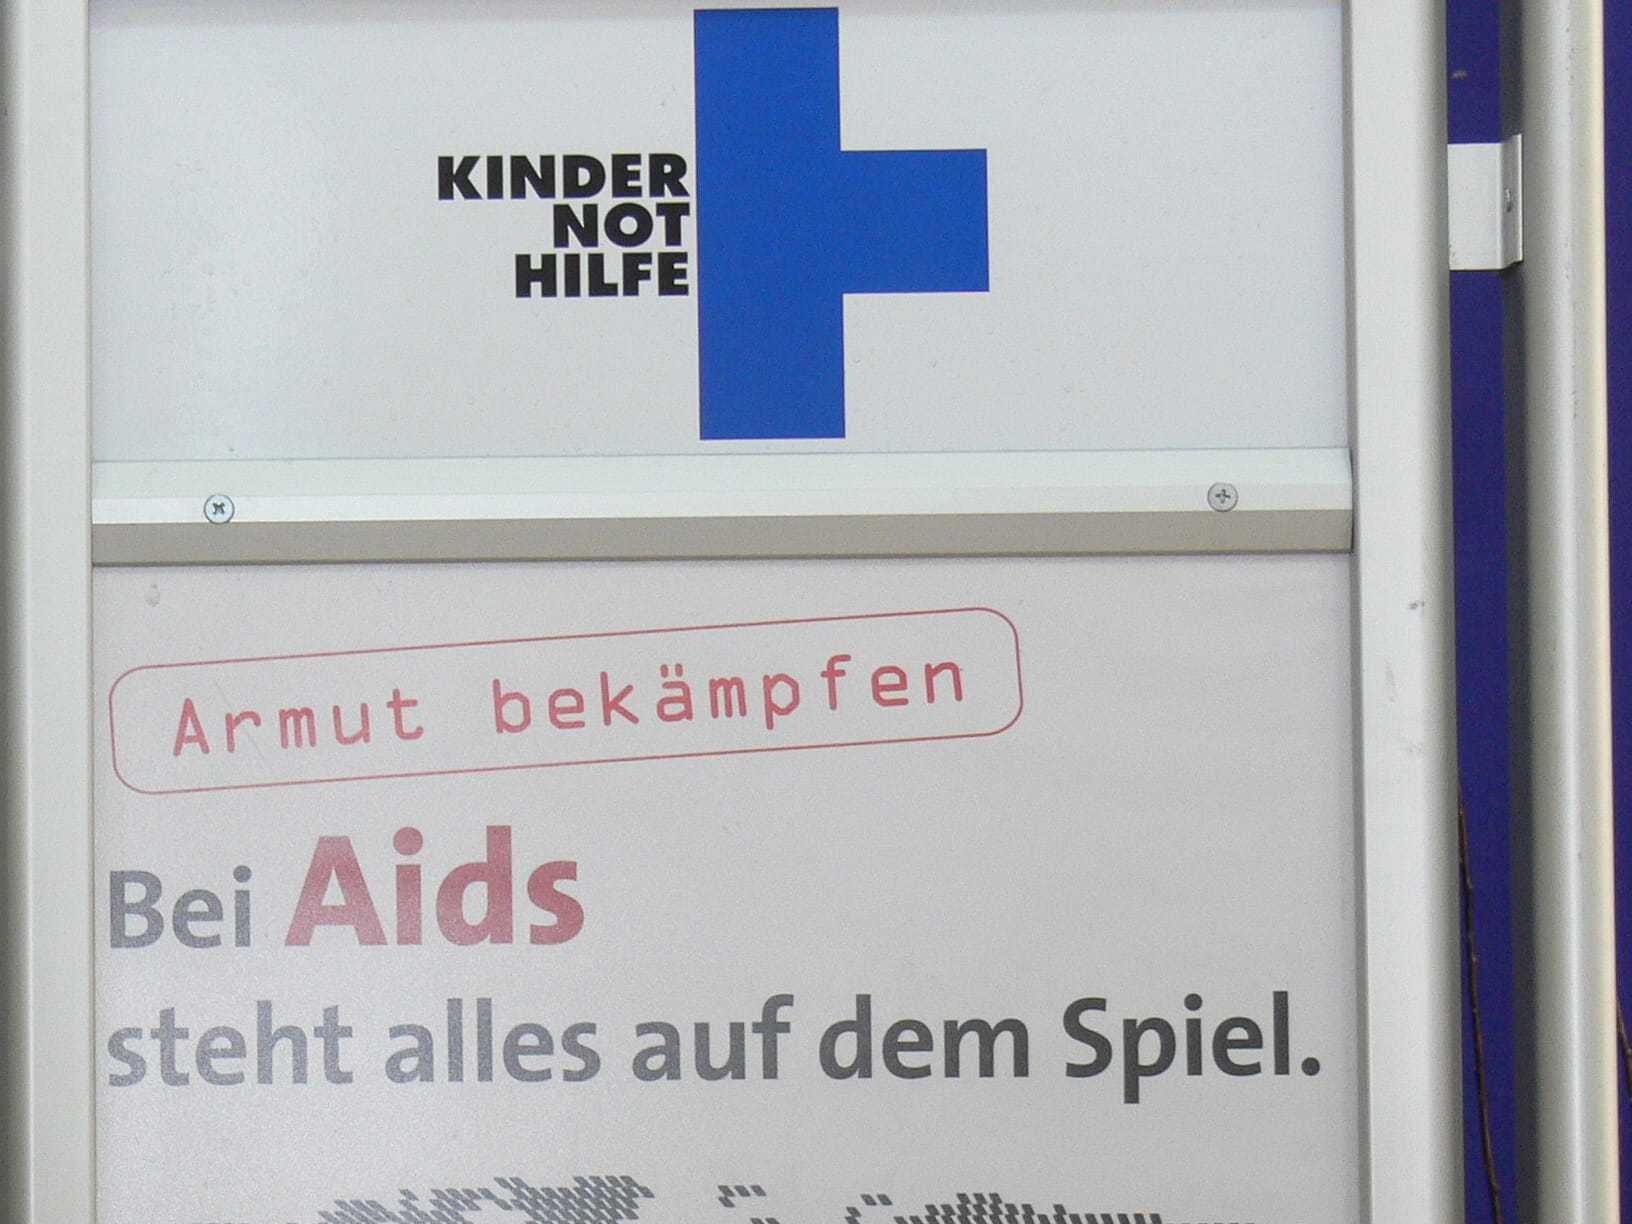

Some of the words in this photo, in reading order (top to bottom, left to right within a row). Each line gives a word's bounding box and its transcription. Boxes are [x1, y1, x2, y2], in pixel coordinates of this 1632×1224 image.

[437, 152, 691, 201] KINDER
[552, 201, 691, 249] NOT
[514, 251, 690, 299] HILFE
[171, 685, 426, 758] Armut
[492, 652, 967, 735] bekämpfen
[109, 865, 252, 949] Bei
[284, 825, 586, 948] Aids
[107, 1000, 353, 1087] steht
[385, 997, 602, 1084] alles
[631, 993, 795, 1083] auf
[818, 993, 1030, 1081] dem
[1062, 989, 1322, 1105] Spiel.
